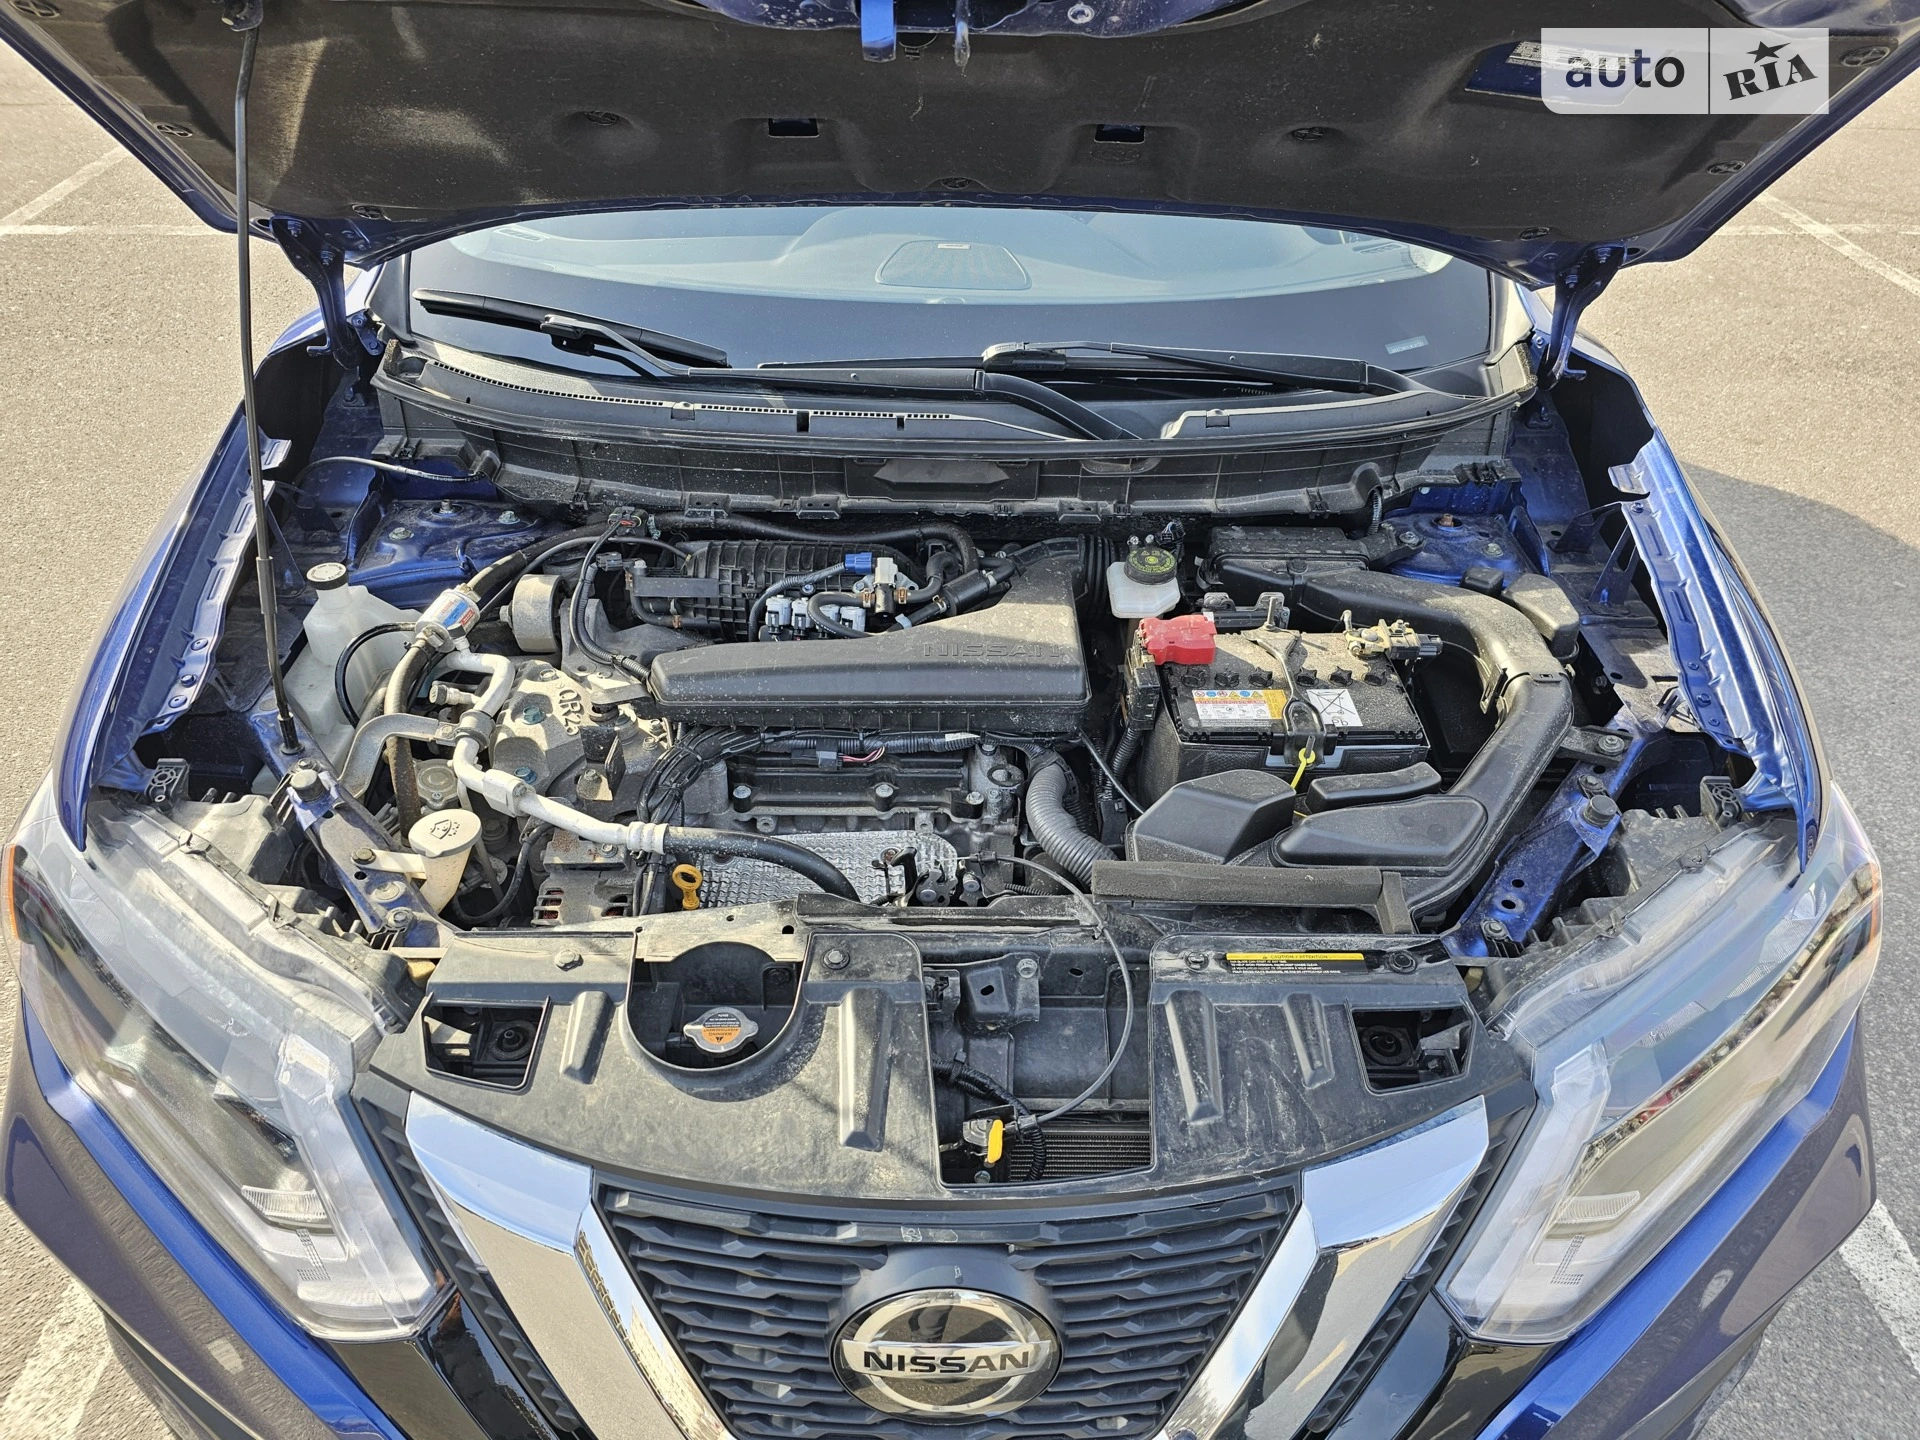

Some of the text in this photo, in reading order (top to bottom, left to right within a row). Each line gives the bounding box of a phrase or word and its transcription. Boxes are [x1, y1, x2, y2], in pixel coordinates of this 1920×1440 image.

[923, 643, 1059, 657] NISSAN
[1331, 717, 1349, 726] Pb
[863, 1351, 1030, 1374] NISSAN
